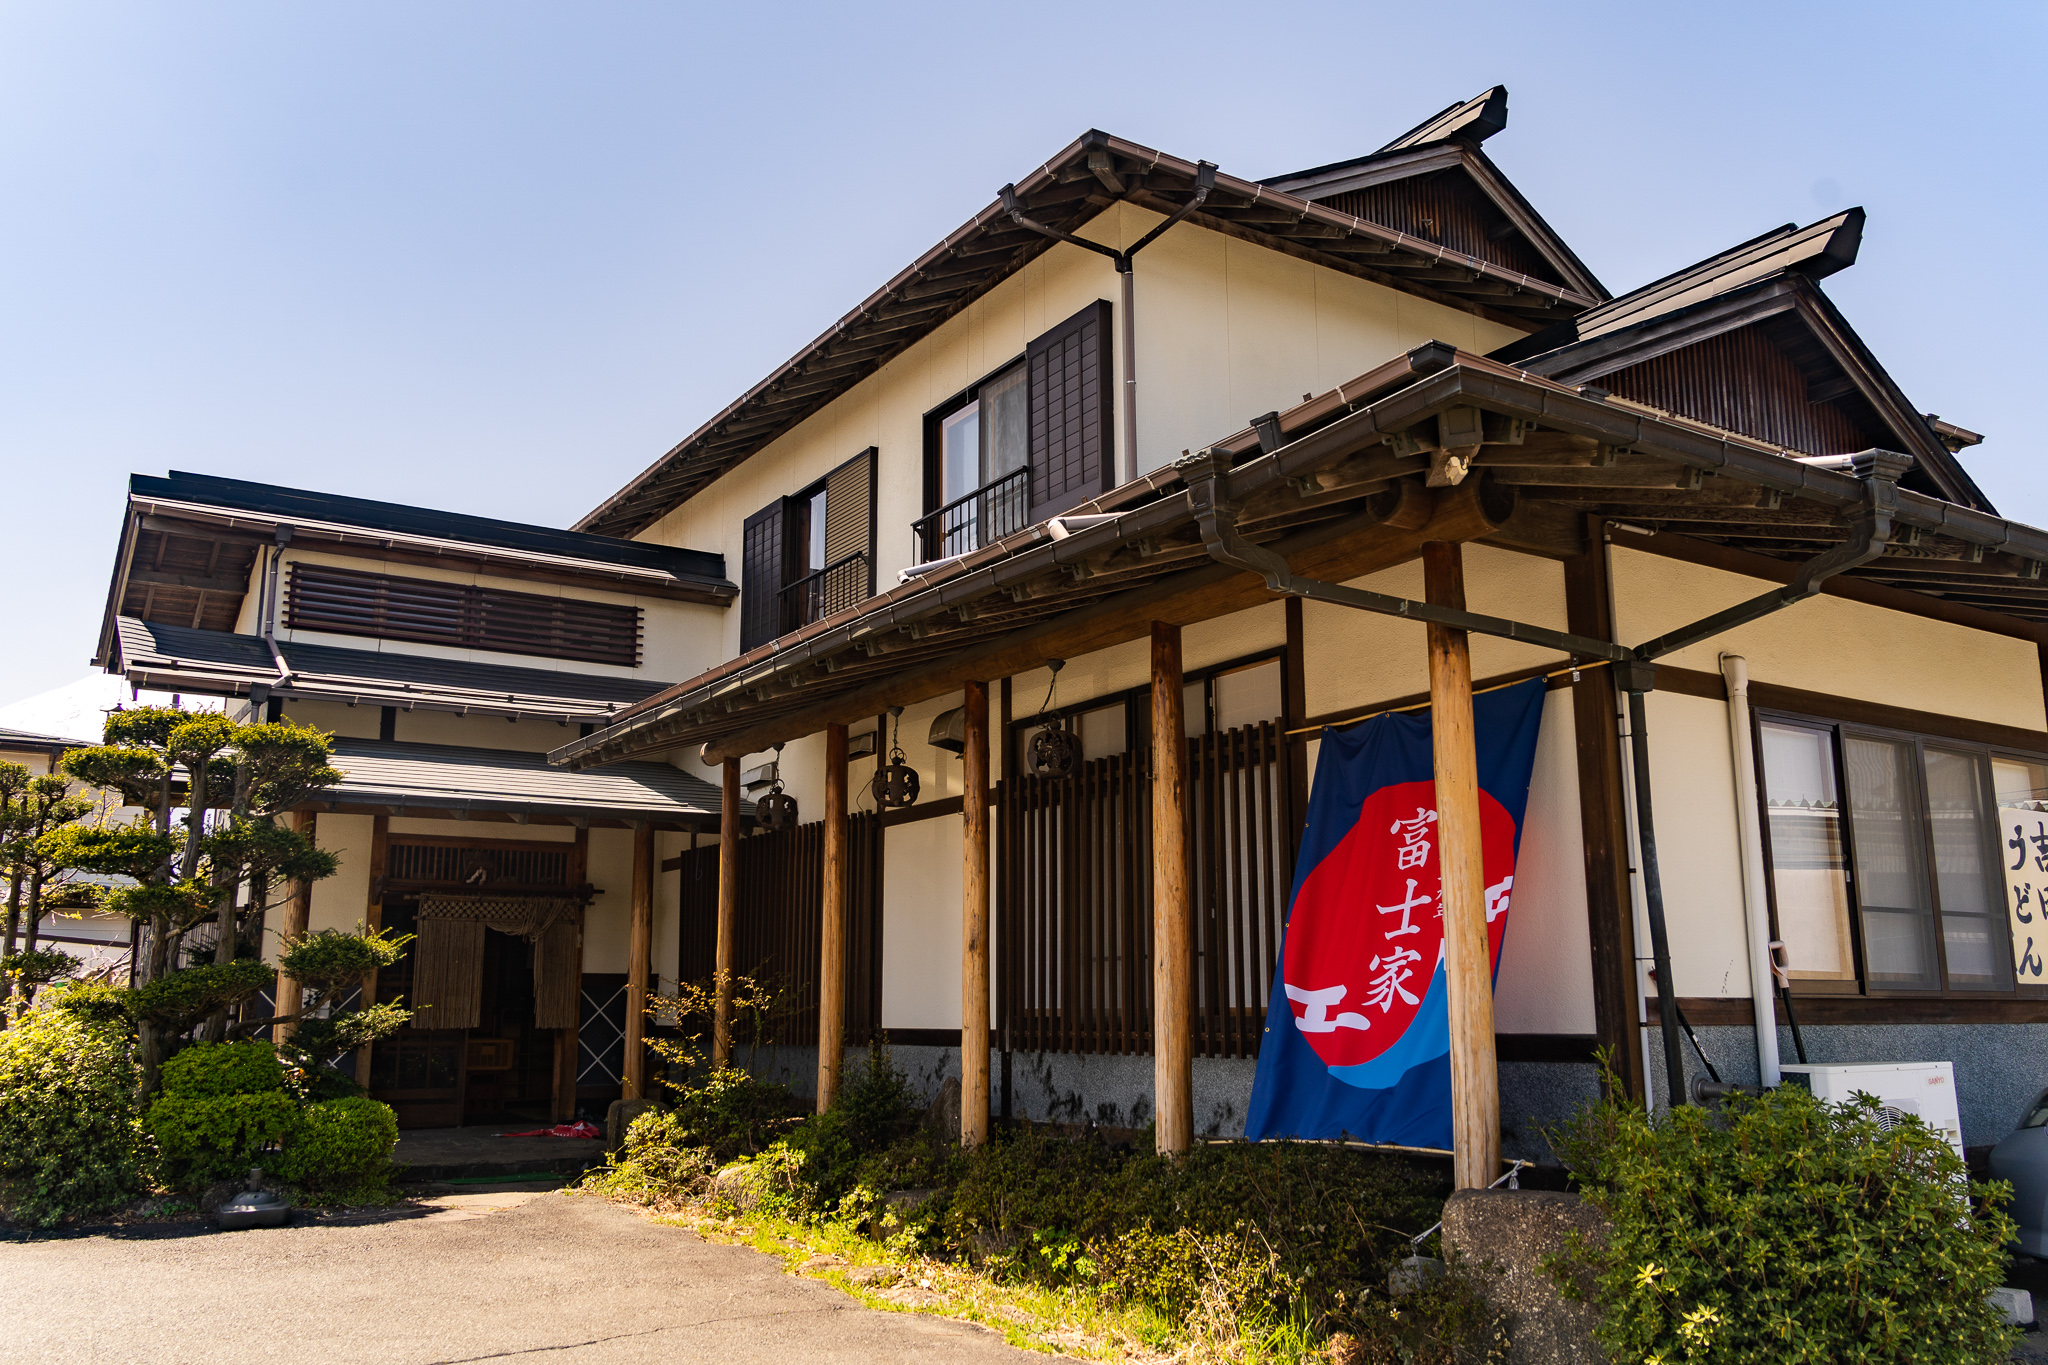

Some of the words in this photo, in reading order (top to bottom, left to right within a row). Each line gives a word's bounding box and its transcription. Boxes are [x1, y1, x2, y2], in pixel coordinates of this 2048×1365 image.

[1362, 807, 1438, 1013] 富士家
[2009, 825, 2043, 977] うどん
[1928, 1075, 1945, 1085] SANYO
